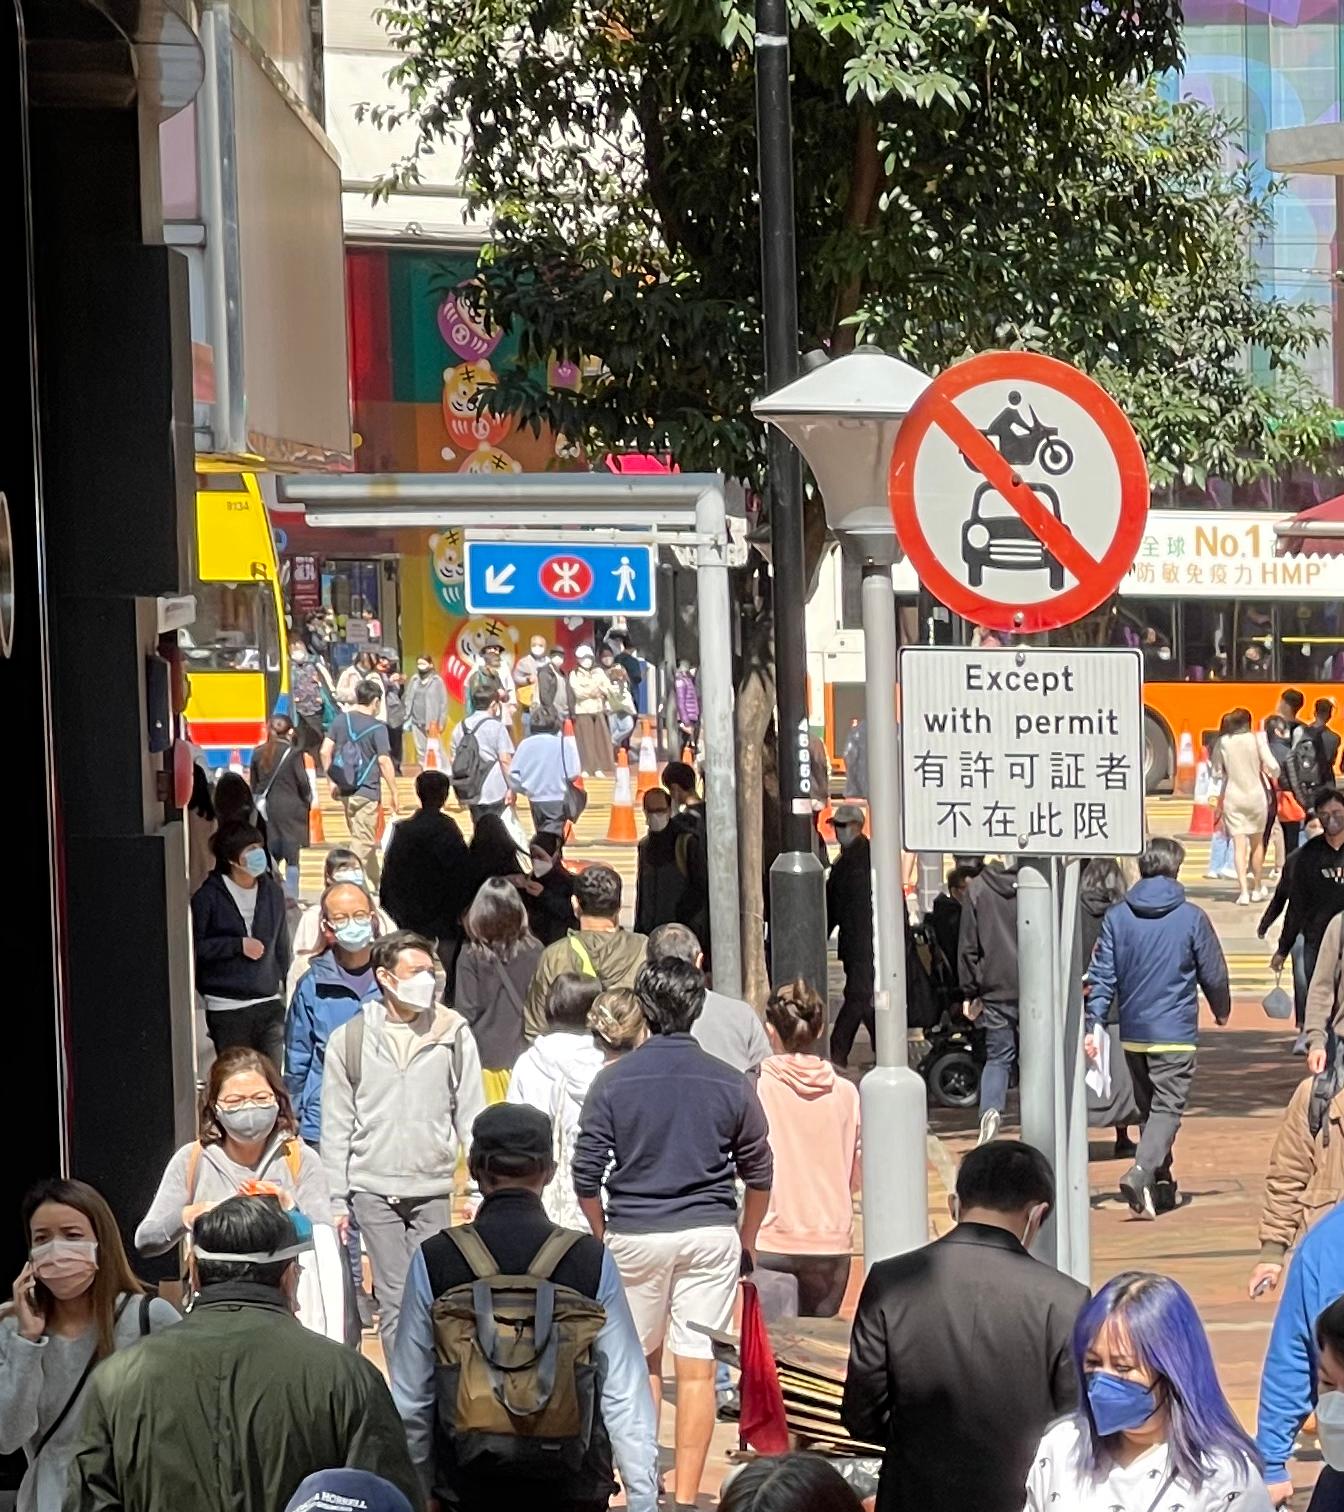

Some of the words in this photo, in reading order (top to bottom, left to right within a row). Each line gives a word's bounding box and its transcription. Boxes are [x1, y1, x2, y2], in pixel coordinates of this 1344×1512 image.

[1141, 535, 1185, 559] 全球
[1194, 524, 1261, 559] No.1
[1137, 562, 1252, 585] 防敏免疫力
[1261, 563, 1321, 585] HMP
[966, 663, 1074, 697] Except
[924, 706, 992, 735] with
[1015, 708, 1119, 740] permit
[913, 749, 1132, 791] 有許可証者
[936, 800, 1110, 840] 不在此限
